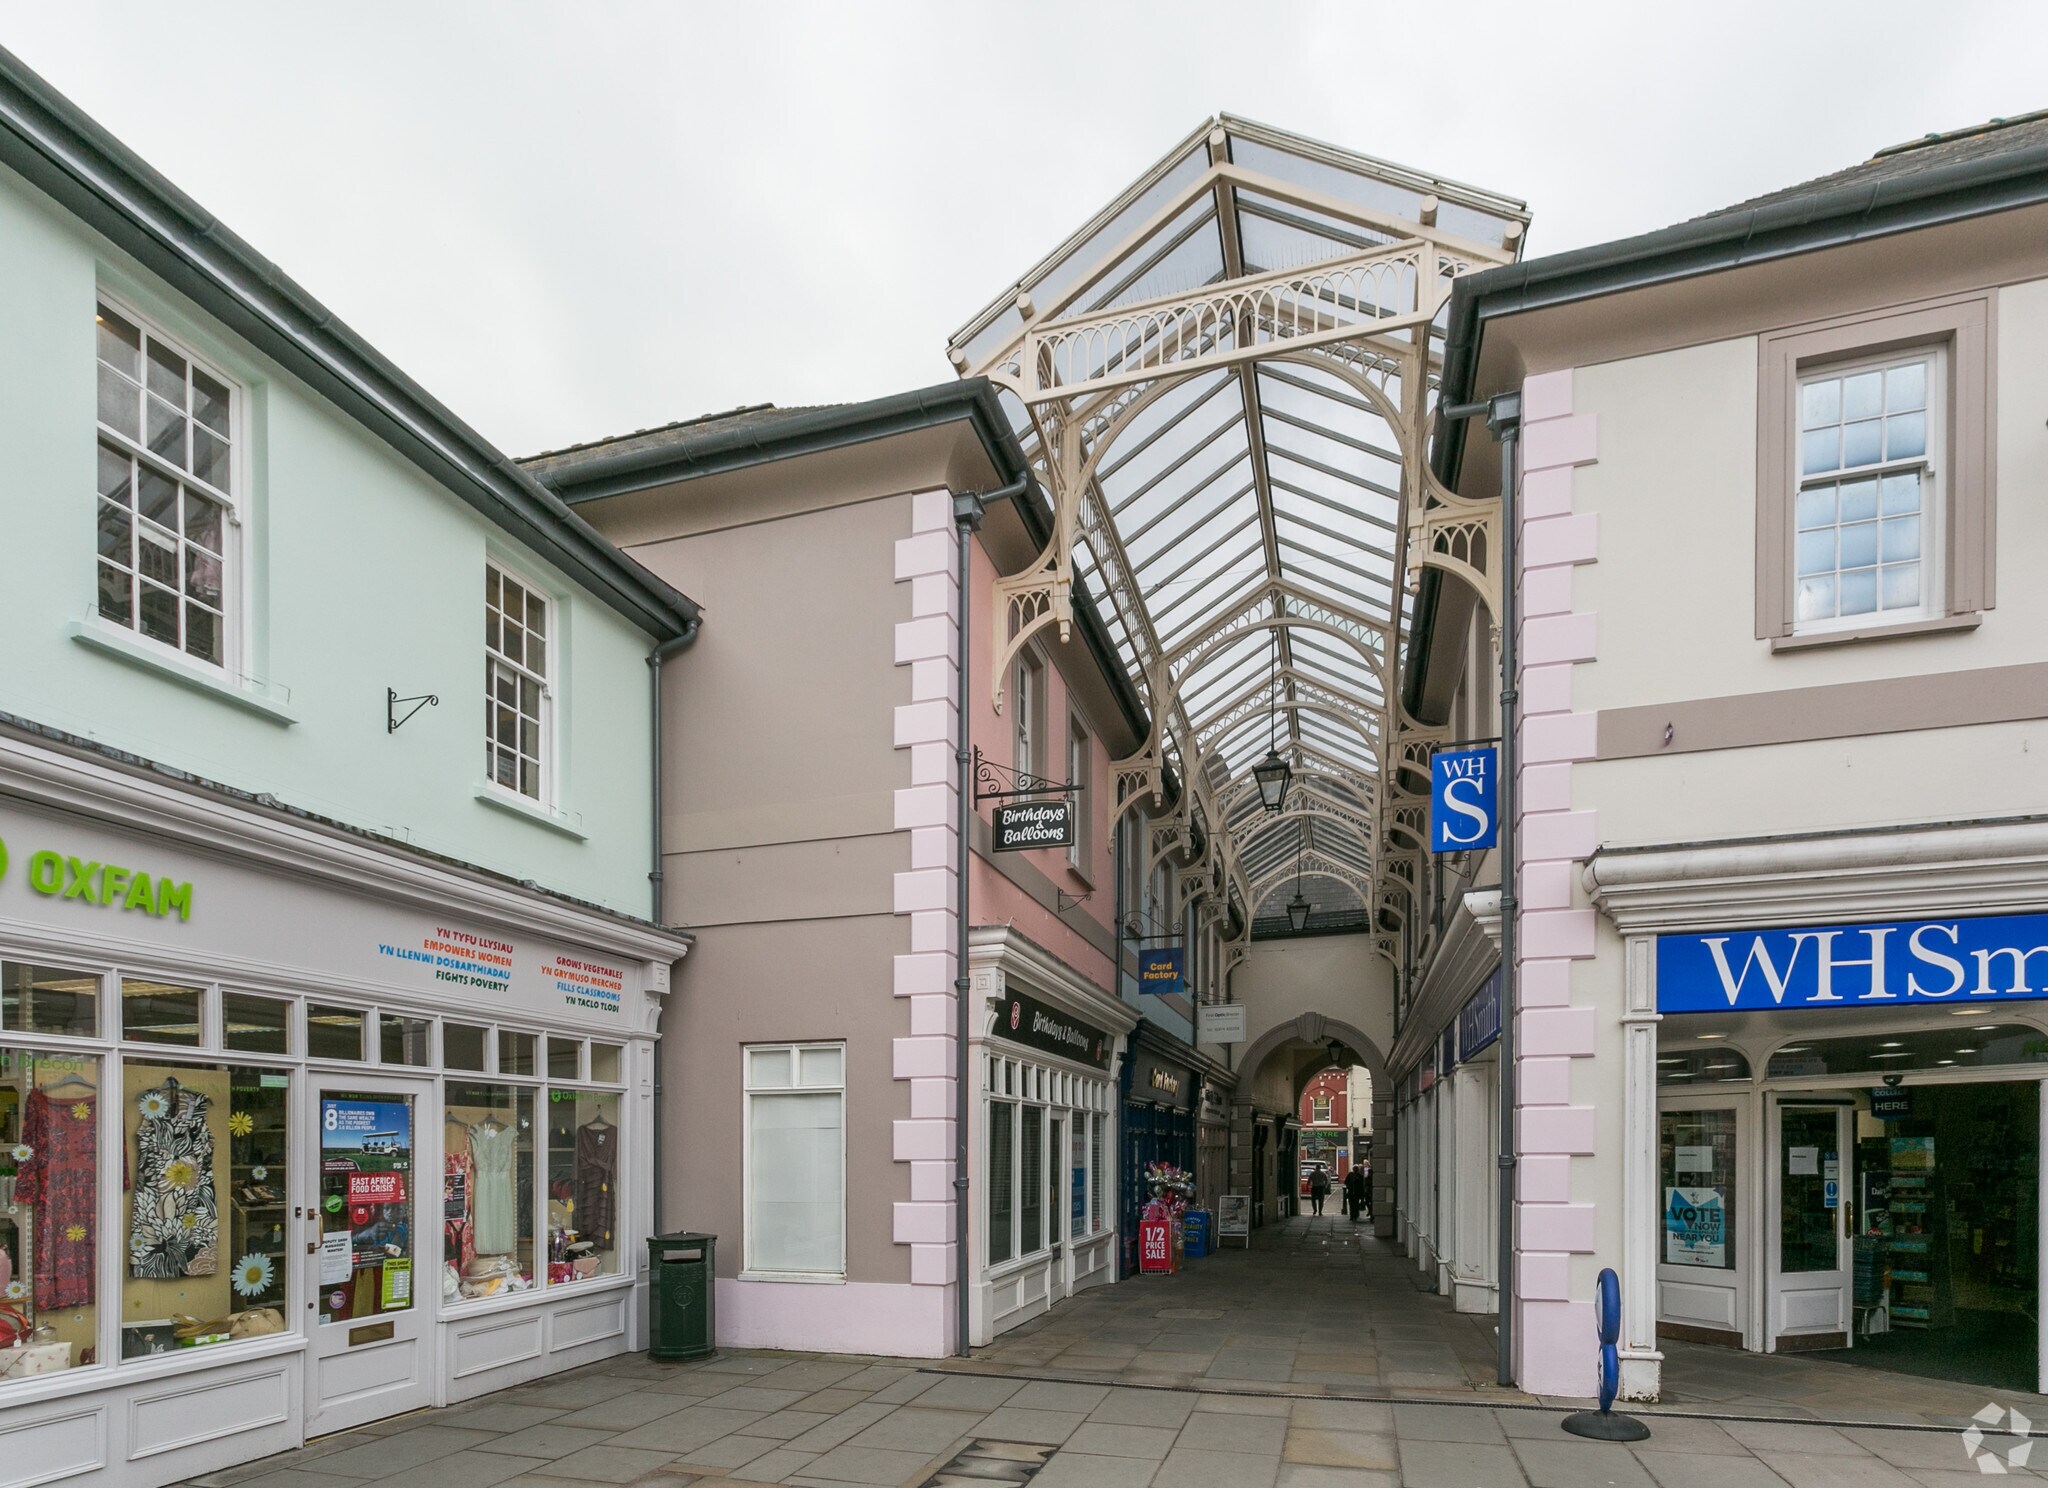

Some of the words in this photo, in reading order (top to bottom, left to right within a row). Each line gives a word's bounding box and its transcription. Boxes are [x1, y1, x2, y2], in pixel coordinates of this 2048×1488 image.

[1441, 757, 1486, 778] WH
[1002, 807, 1065, 825] Birthdays
[1442, 777, 1488, 843] S
[1036, 820, 1044, 829] &
[1003, 826, 1064, 844] Balloons
[31, 850, 193, 921] OXFAM
[436, 927, 451, 939] YN
[453, 931, 477, 946] TYFU
[478, 936, 514, 954] LLYSIAU
[378, 943, 396, 956] YN
[397, 947, 434, 965] LLENWI
[436, 955, 511, 980] DOSBARTHIADAU
[423, 939, 476, 959] EMPOWERS
[478, 951, 512, 967] WOMEN
[556, 956, 582, 970] GROWS
[583, 962, 623, 980] VEGETABLES
[1144, 970, 1178, 980] Factory
[1150, 962, 1172, 971] Card
[436, 970, 469, 986] FIGHTS
[470, 976, 509, 992] POVERTY
[540, 965, 552, 976] YN
[554, 968, 590, 984] GRYMUSO
[590, 975, 622, 992] MERCHED
[556, 981, 575, 993] FILLS
[576, 986, 621, 1002] CLASSROOMS
[565, 995, 576, 1005] YN
[578, 998, 599, 1009] TACLO
[600, 1002, 620, 1014] TLODI
[1032, 1011, 1062, 1040] Birthdays
[1066, 1026, 1089, 1052] Balloons
[1874, 1101, 1908, 1111] HERE
[325, 1109, 337, 1130] 8
[370, 1177, 395, 1185] AFRICA
[1671, 1208, 1720, 1225] VOTE
[1146, 1227, 1165, 1241] 1/2
[1694, 1222, 1720, 1231] NOW
[1699, 1234, 1719, 1242] YOU
[1146, 1250, 1165, 1259] SALE
